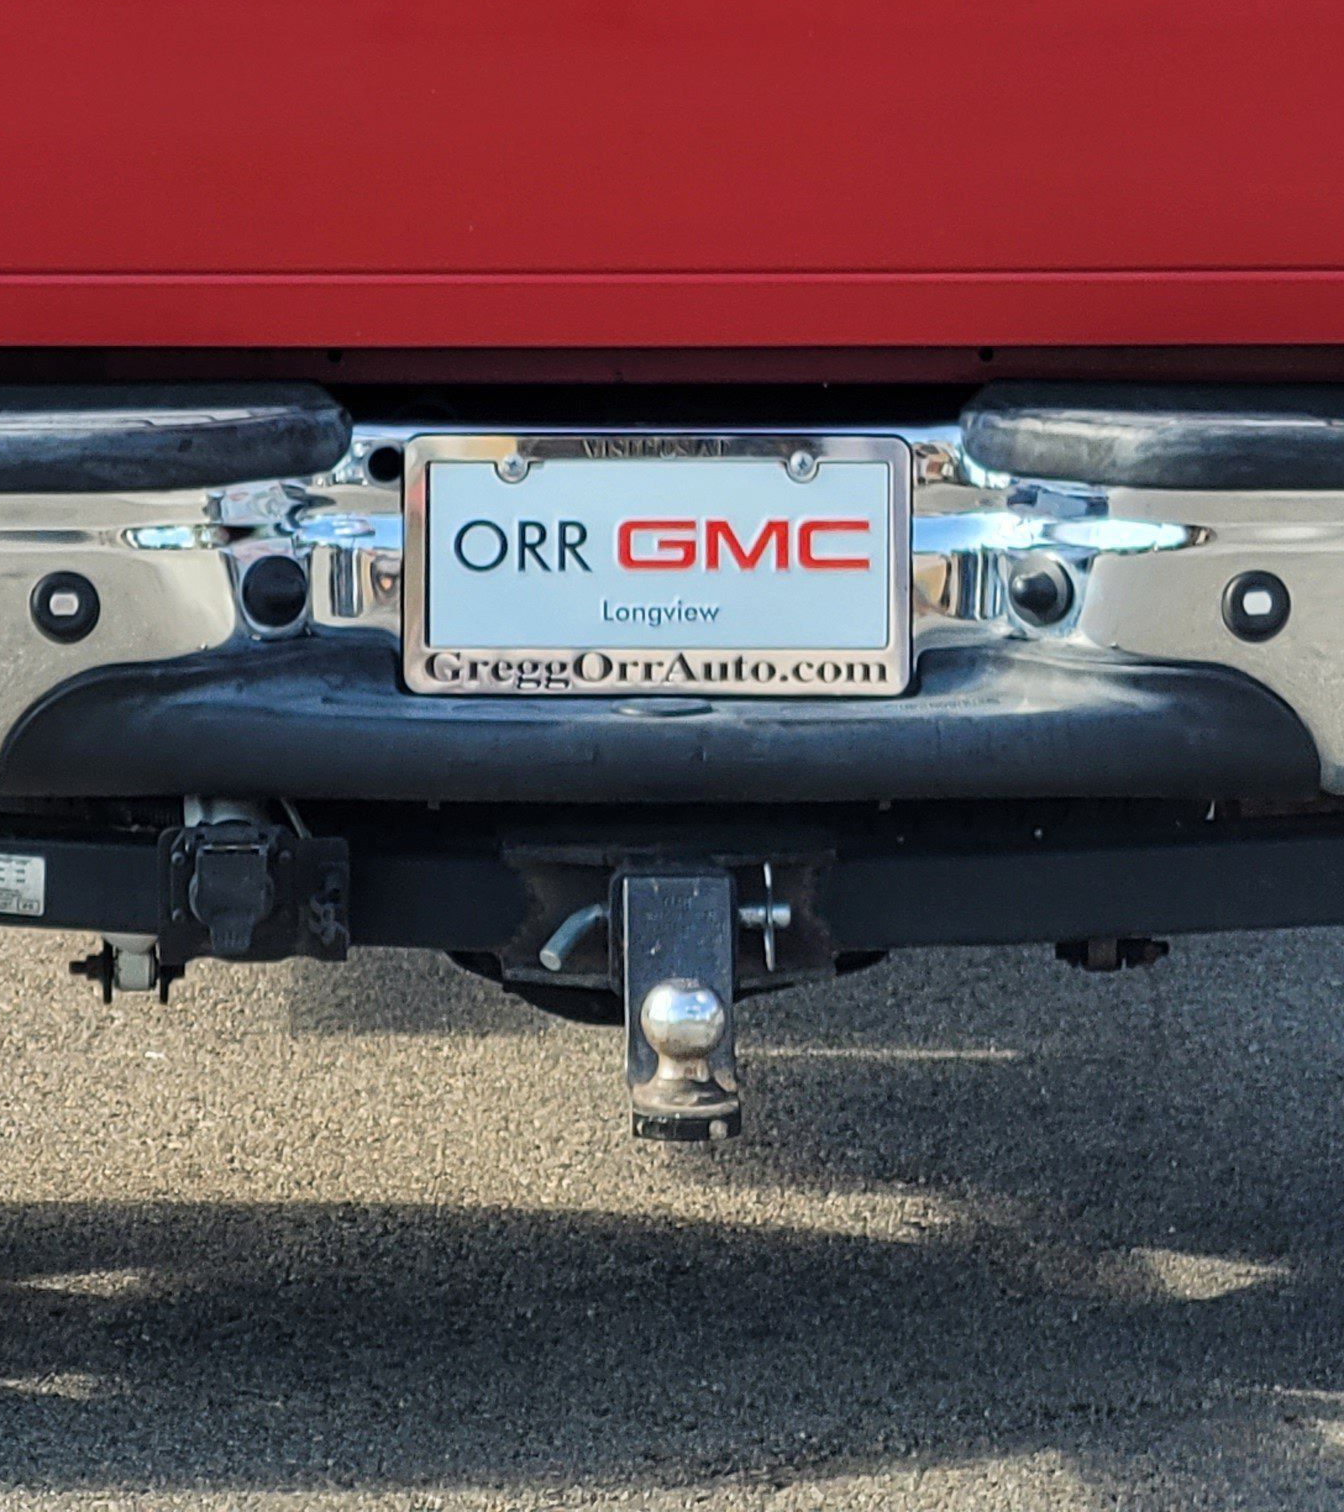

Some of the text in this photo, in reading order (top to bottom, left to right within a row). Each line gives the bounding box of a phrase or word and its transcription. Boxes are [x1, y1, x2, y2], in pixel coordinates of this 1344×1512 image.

[454, 519, 871, 573] ORR GMC
[602, 600, 721, 627] Longview
[424, 651, 889, 690] GreggOrrAuto.com
